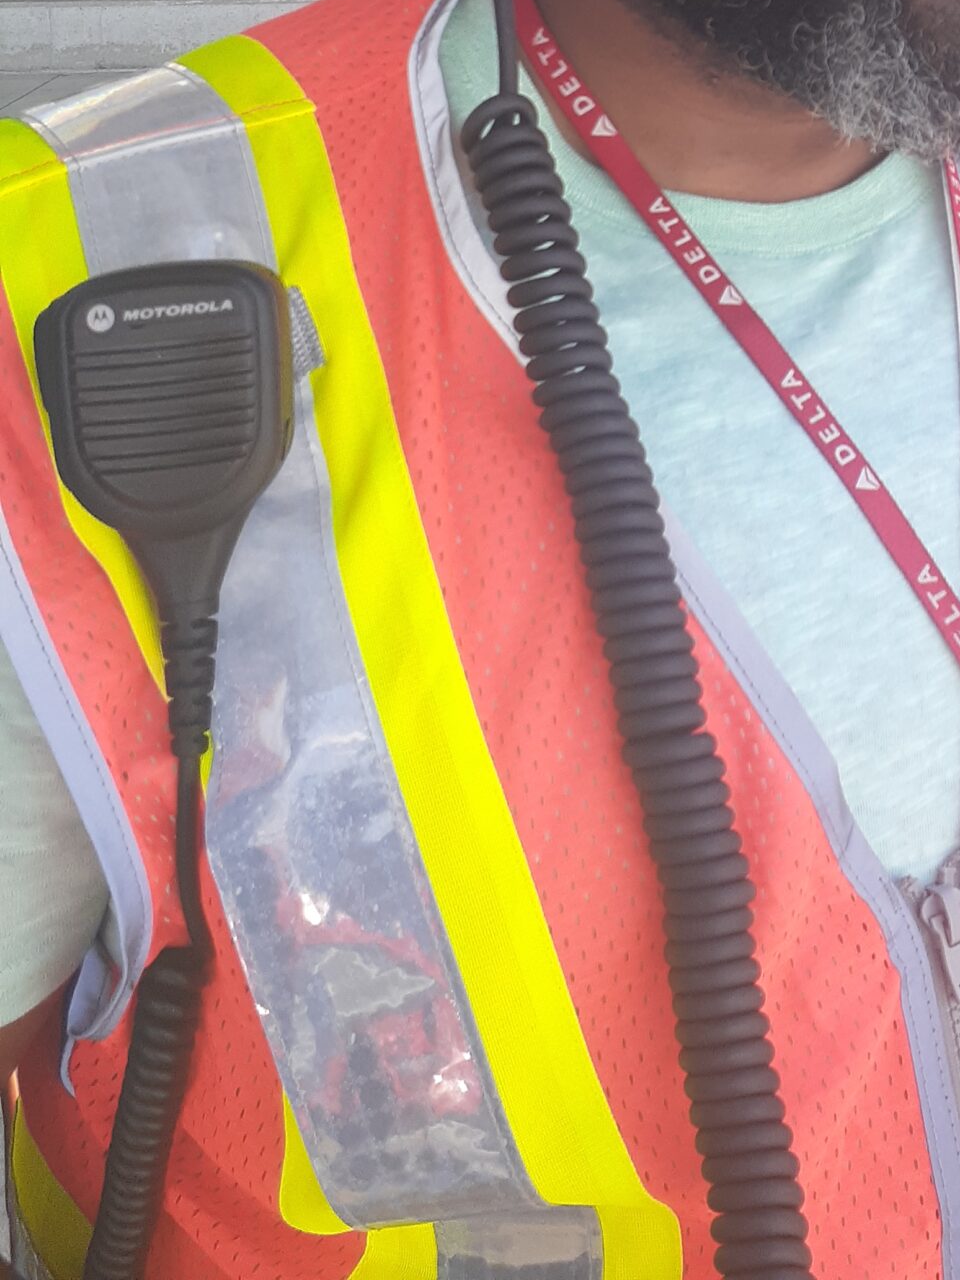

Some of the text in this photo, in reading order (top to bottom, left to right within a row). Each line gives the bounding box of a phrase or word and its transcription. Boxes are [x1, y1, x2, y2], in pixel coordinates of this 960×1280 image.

[531, 27, 596, 117] DELTA
[649, 196, 722, 285] DELTA
[122, 299, 234, 322] MOTOROLA
[781, 368, 857, 466] DELTA
